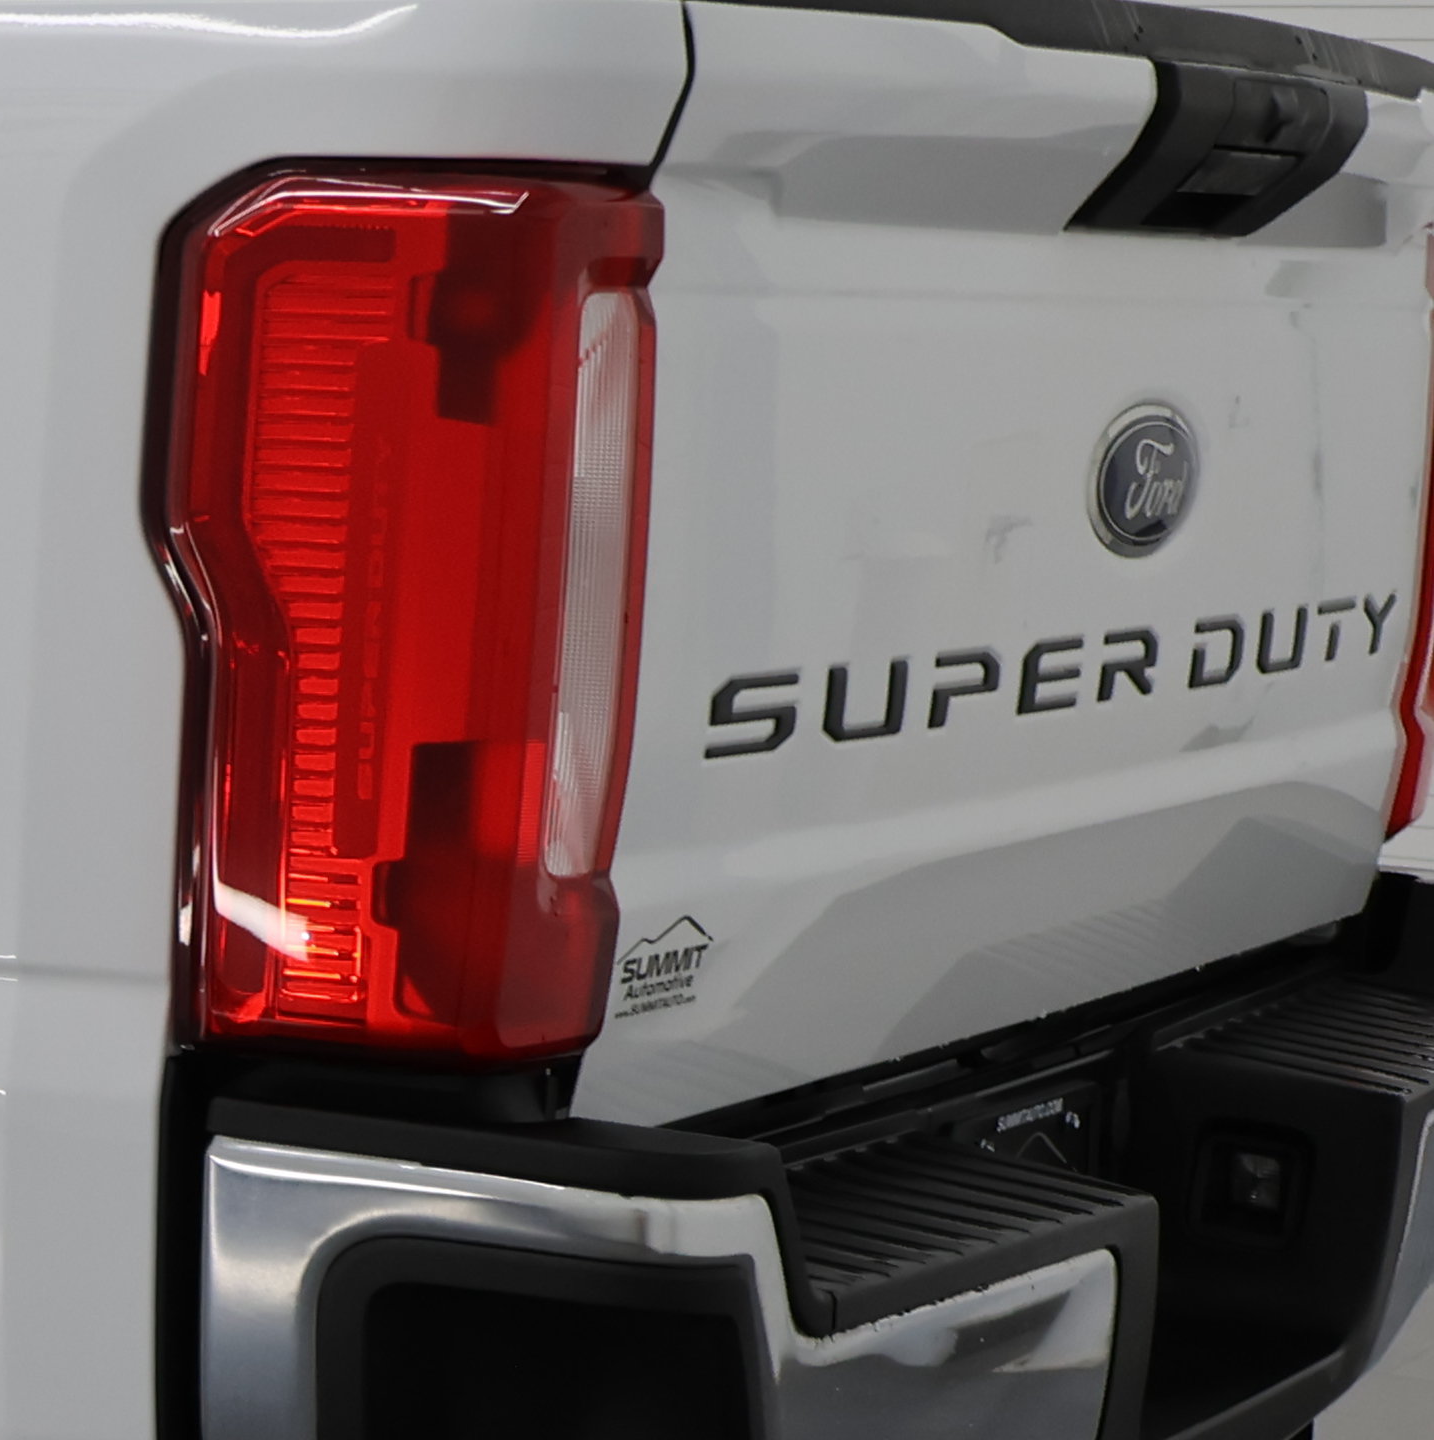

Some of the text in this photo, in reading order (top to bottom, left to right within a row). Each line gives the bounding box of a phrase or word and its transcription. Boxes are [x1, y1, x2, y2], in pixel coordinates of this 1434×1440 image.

[1124, 439, 1189, 520] Ford
[703, 590, 1397, 760] SUPER DUTY
[621, 943, 708, 984] SUMMIT
[623, 975, 694, 1001] Automotive
